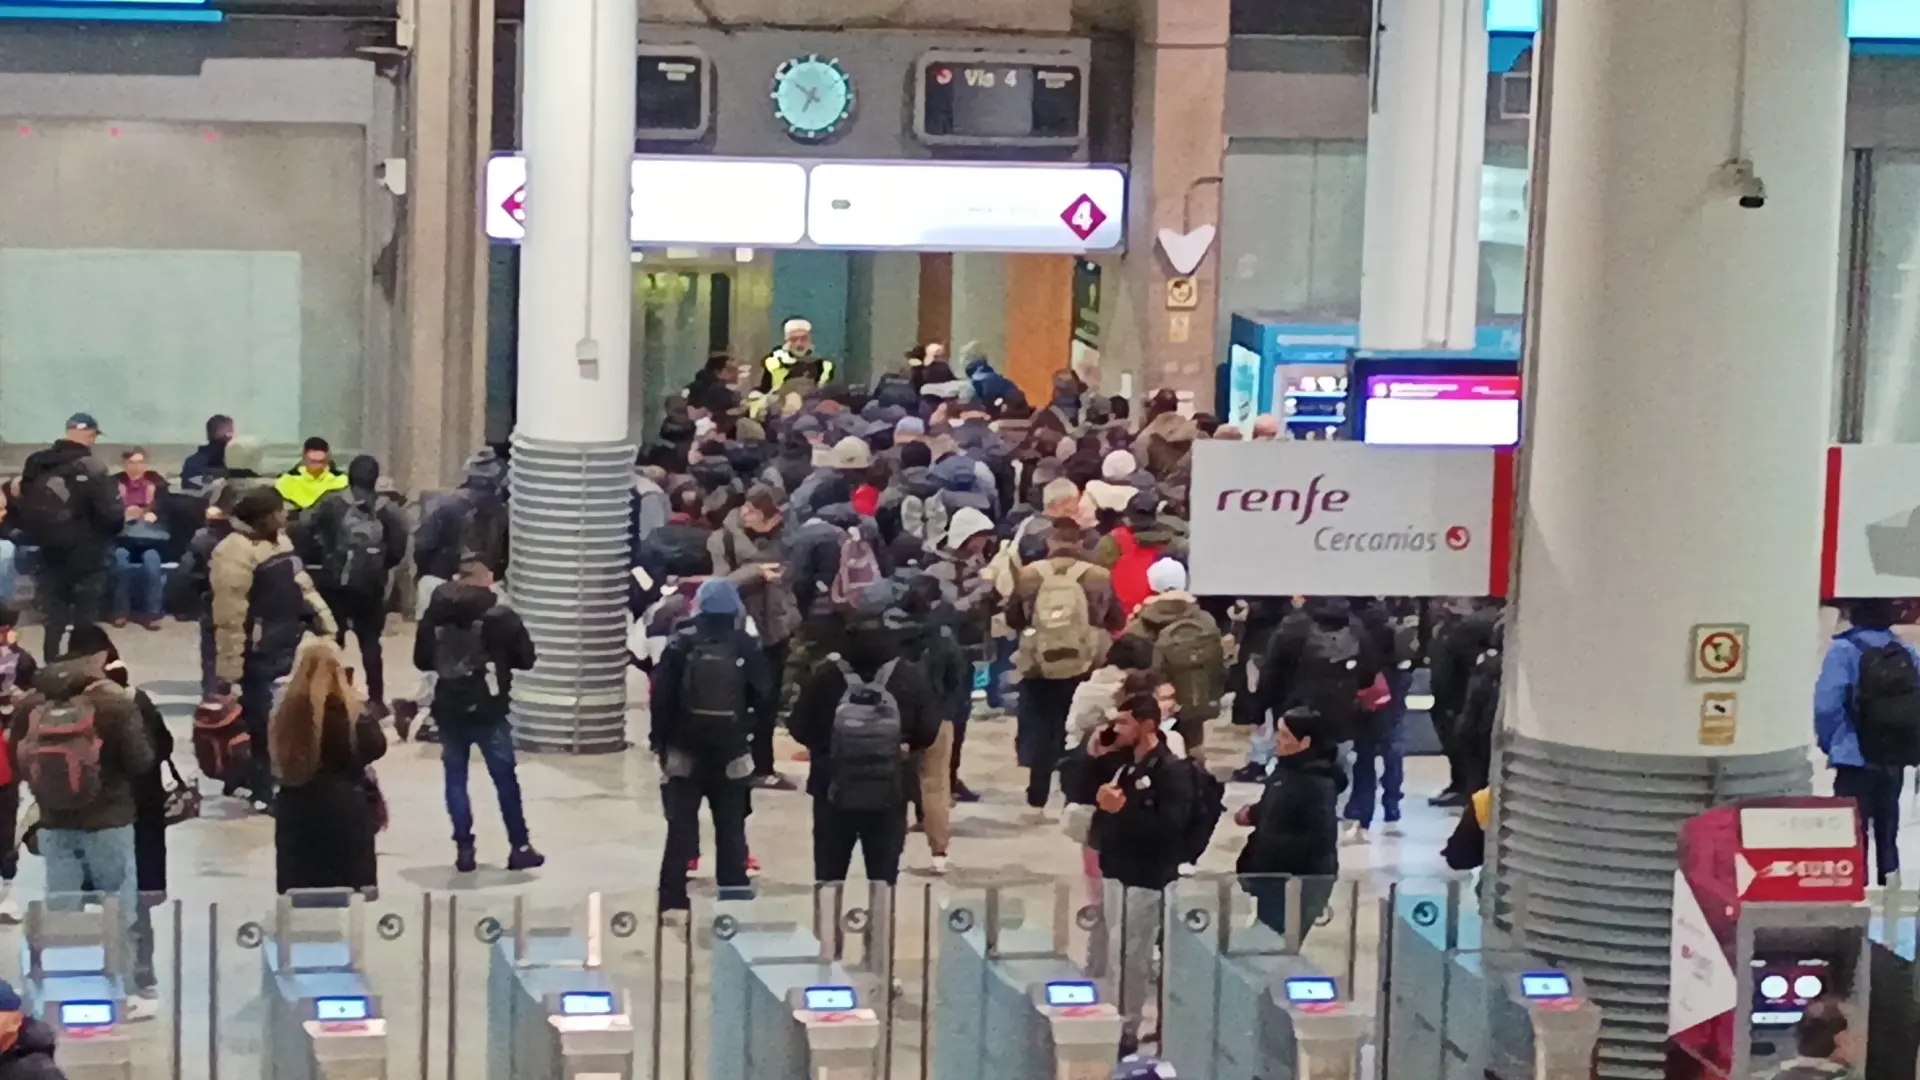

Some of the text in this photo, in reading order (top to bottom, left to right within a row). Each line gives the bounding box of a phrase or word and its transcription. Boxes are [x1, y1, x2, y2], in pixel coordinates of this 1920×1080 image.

[1004, 70, 1017, 87] 4
[1072, 201, 1094, 230] 4
[1217, 473, 1350, 525] renfe
